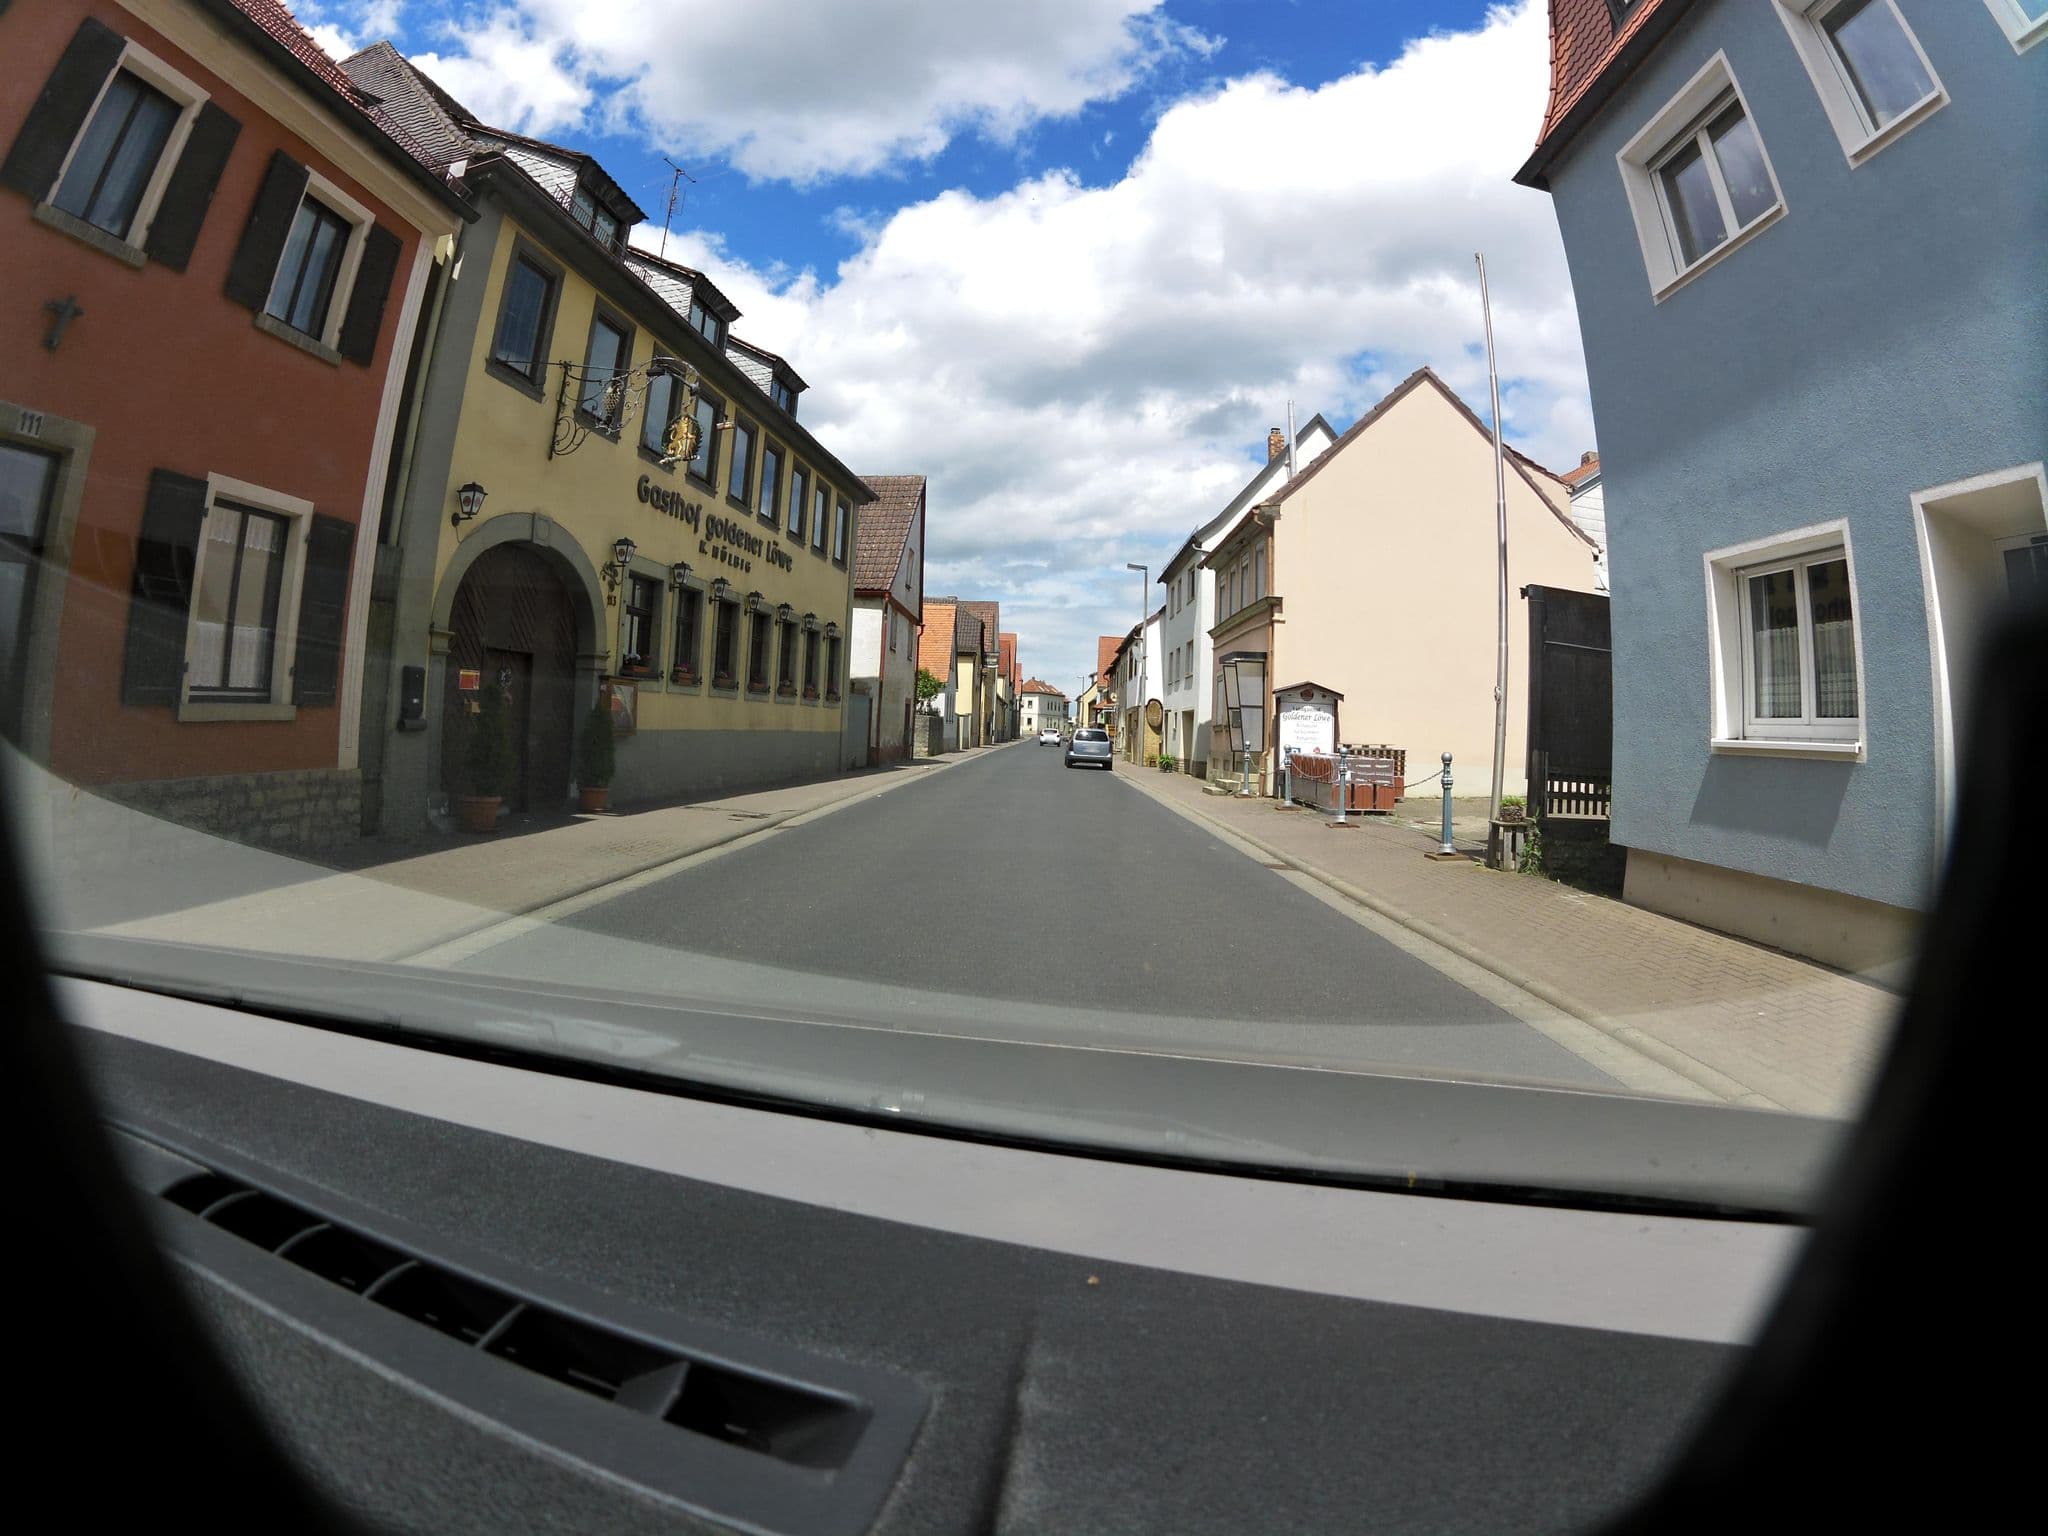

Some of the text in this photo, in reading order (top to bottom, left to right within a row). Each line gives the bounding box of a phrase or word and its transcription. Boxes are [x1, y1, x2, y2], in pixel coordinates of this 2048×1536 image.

[20, 410, 43, 436] 111
[637, 474, 793, 573] Gasthof goldener Löwe
[1282, 711, 1331, 722] Goldener Löwe
